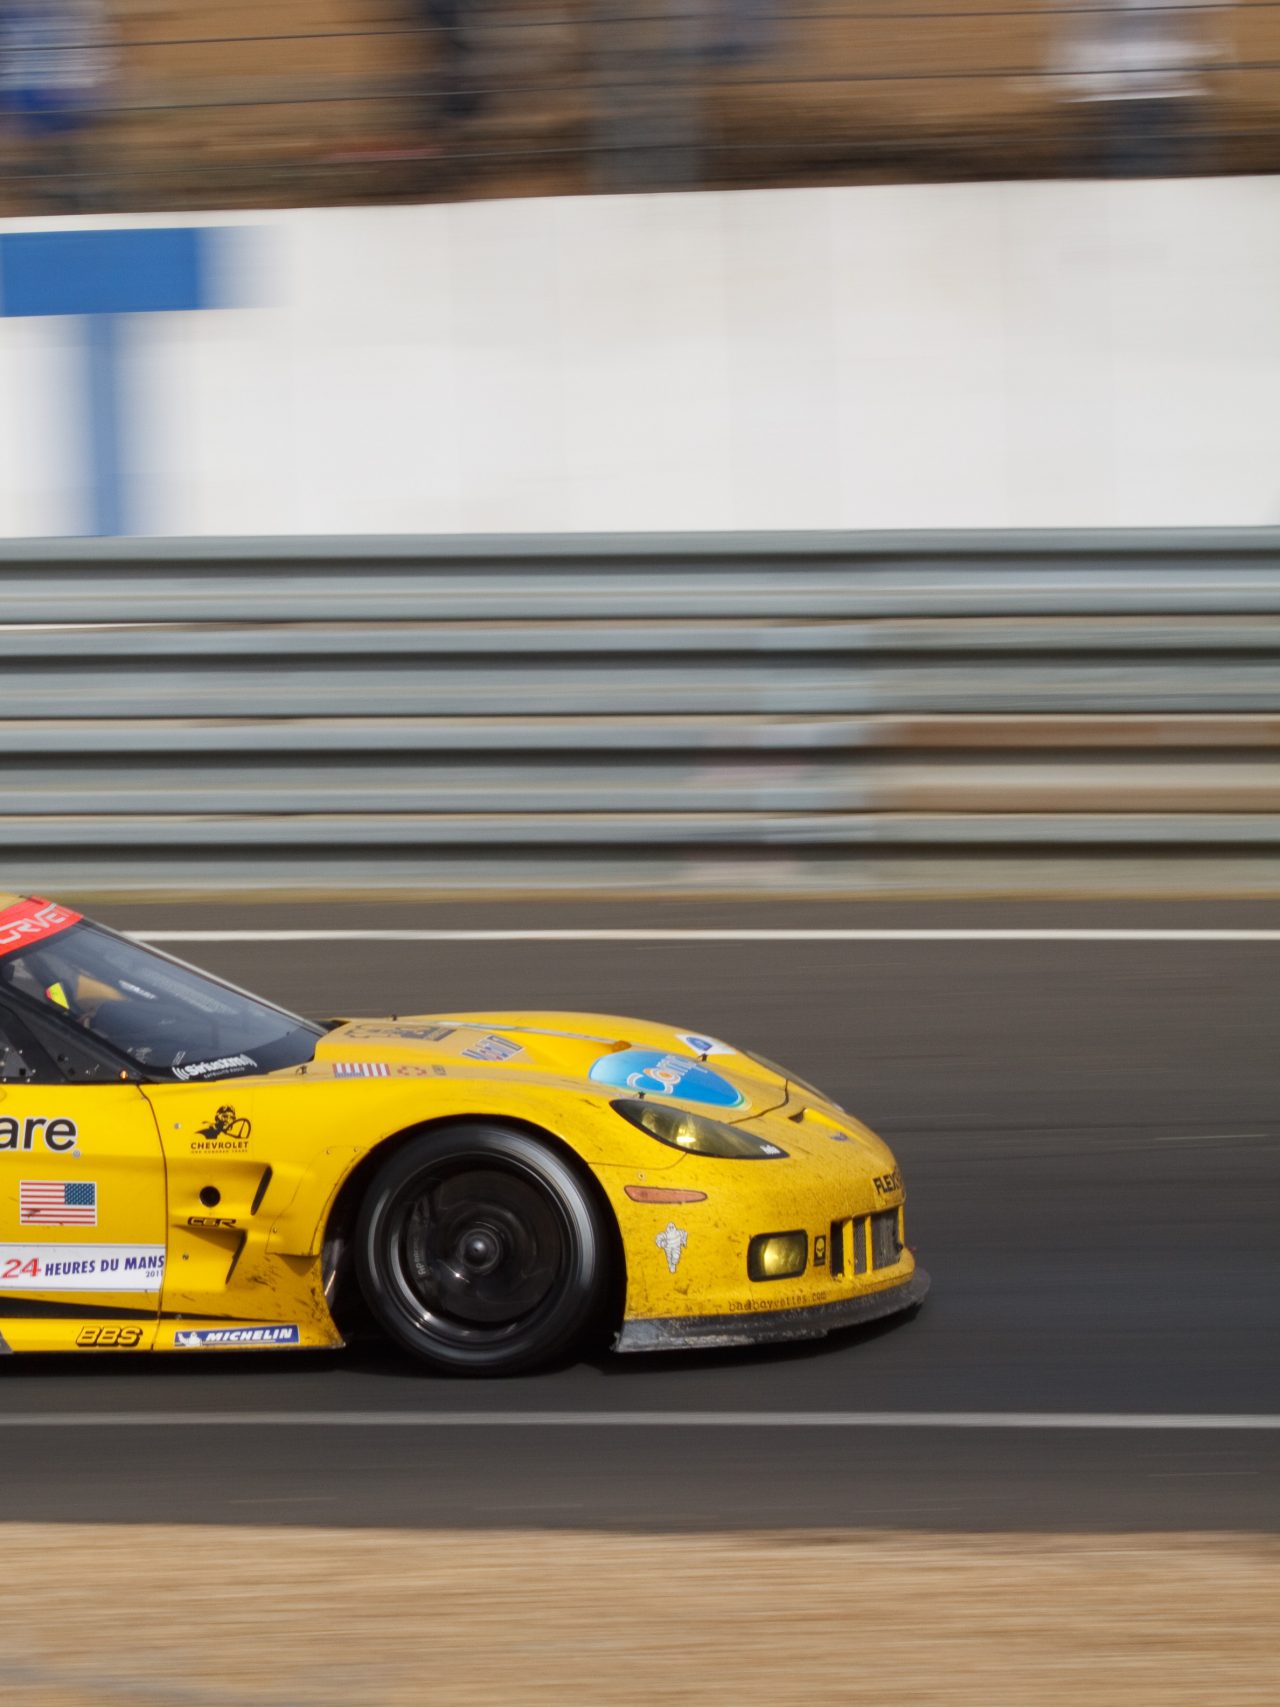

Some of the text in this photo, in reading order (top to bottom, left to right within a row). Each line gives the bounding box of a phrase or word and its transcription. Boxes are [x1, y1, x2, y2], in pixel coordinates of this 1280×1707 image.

[190, 1141, 248, 1150] CHEVROLET
[1, 1255, 164, 1279] 24 HEURES DU MANS
[76, 1326, 142, 1346] BBS
[205, 1328, 293, 1342] MICHELIN
